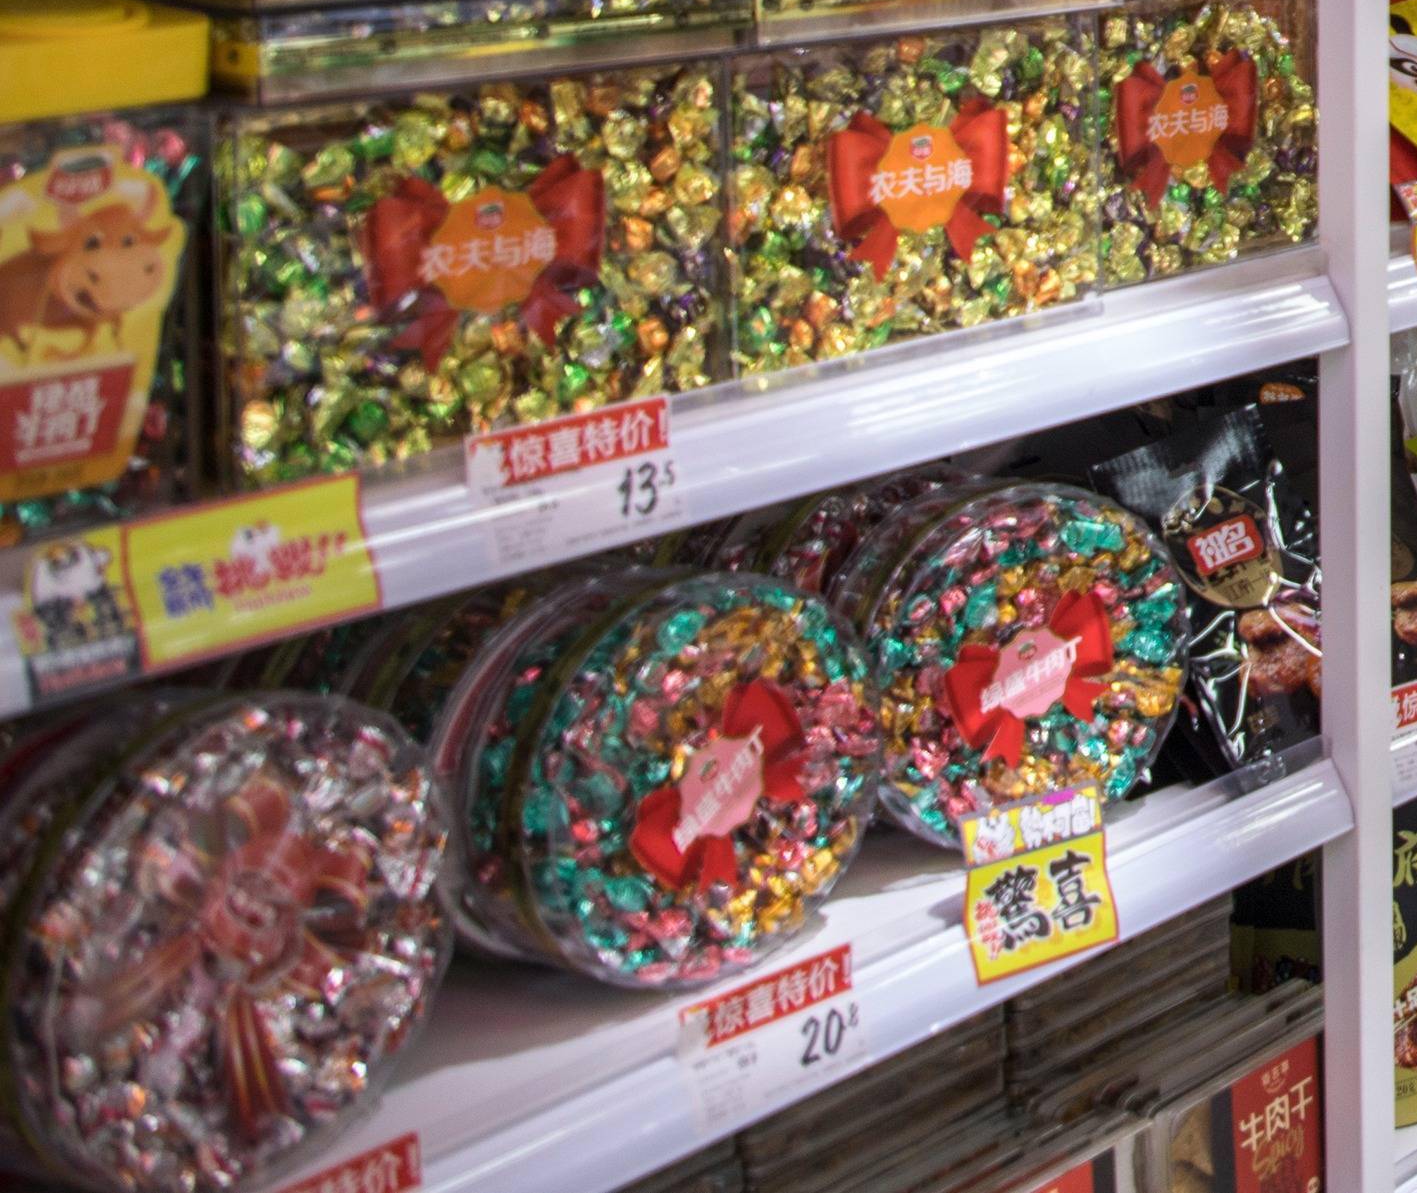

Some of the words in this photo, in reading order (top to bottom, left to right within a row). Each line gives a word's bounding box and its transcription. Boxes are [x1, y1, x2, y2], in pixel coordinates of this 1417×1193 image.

[1144, 103, 1230, 144] 农夫与海
[868, 156, 975, 201] 农夫与海
[420, 224, 558, 284] 农夫与海
[510, 408, 668, 481] 惊喜特价!
[984, 849, 1102, 953] 驚喜
[709, 953, 850, 1043] 惊喜特价!
[1240, 1075, 1314, 1153] 牛肉干
